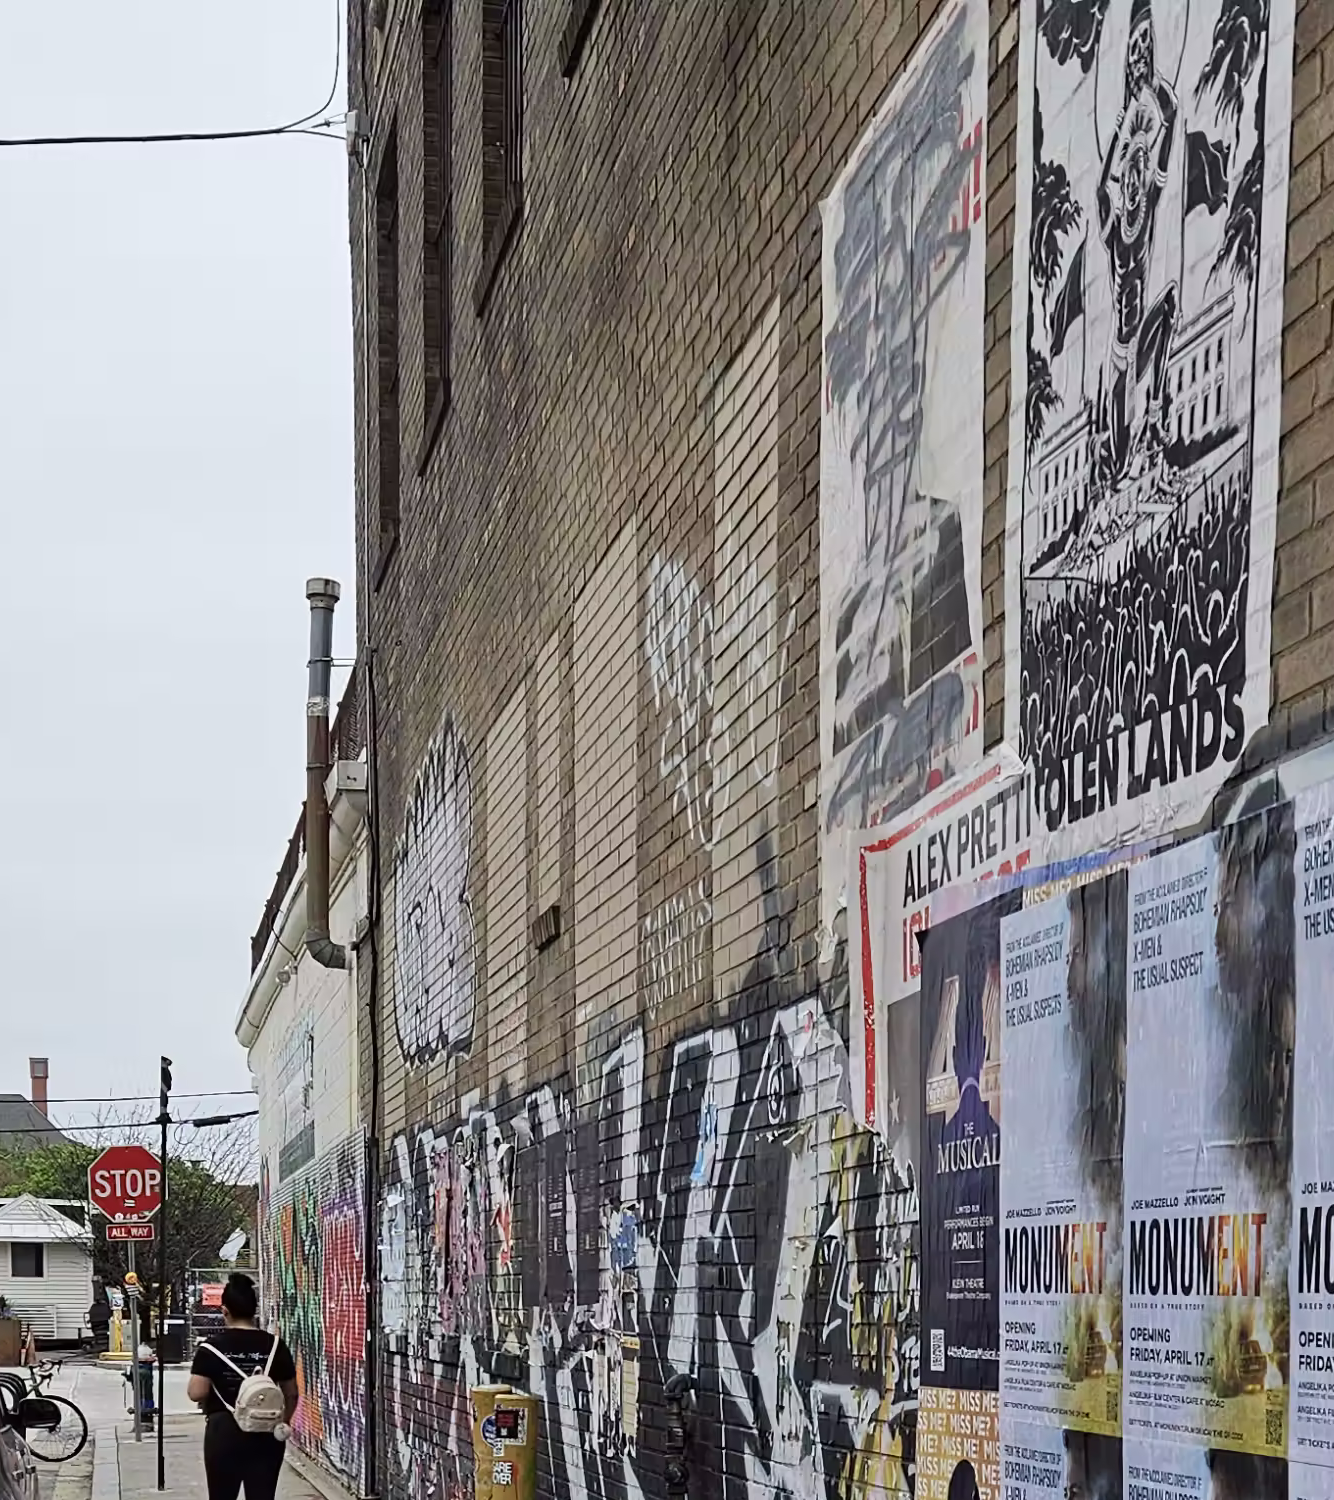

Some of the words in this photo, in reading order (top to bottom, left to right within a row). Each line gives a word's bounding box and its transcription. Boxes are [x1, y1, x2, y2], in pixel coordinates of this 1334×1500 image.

[1127, 668, 1246, 800] LANDS
[903, 824, 952, 908] ALEX
[937, 1133, 1001, 1174] MUSICAL
[94, 1169, 161, 1198] STOP
[111, 1228, 128, 1238] ALL
[130, 1227, 149, 1237] WAY
[951, 1231, 974, 1250] APRIL
[1005, 1222, 1107, 1295] MONUMENT
[1130, 1213, 1267, 1297] MONUMENT
[918, 1389, 937, 1408] MISS
[939, 1390, 956, 1410] ME?
[960, 1391, 980, 1412] MISS
[930, 1412, 946, 1431] ME?
[950, 1414, 971, 1434] MISS
[973, 1416, 991, 1437] ME?
[920, 1434, 938, 1452] ME?
[942, 1436, 961, 1456] MISS
